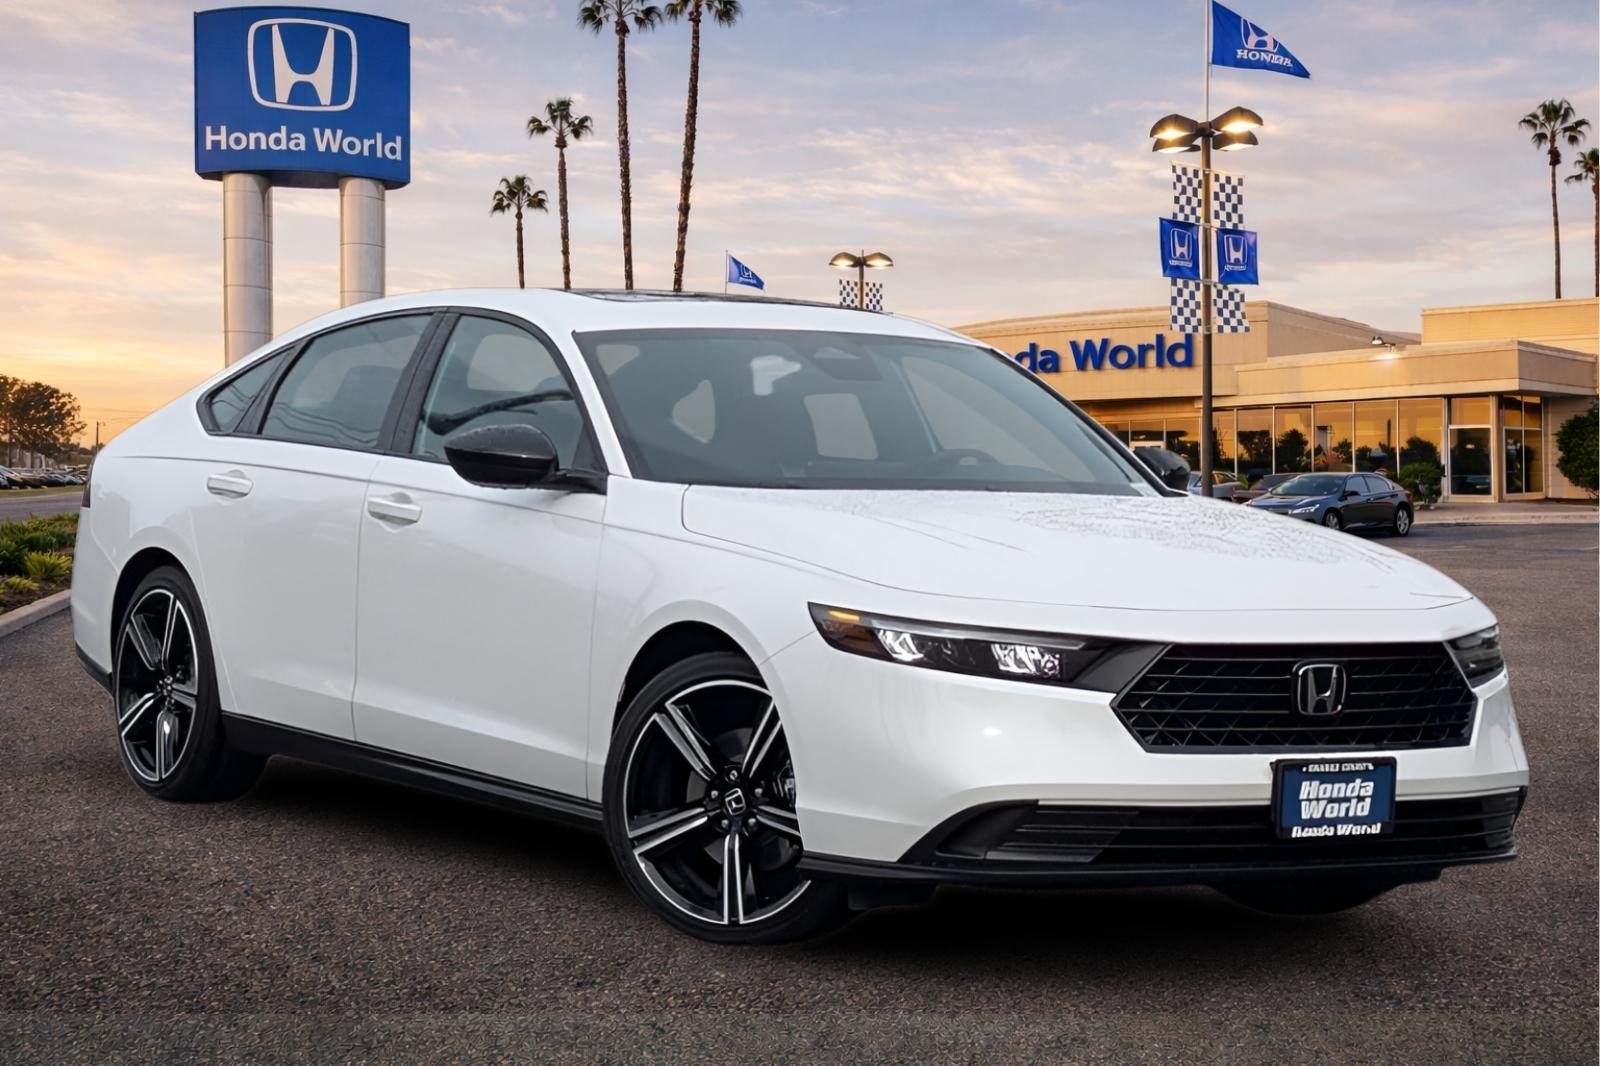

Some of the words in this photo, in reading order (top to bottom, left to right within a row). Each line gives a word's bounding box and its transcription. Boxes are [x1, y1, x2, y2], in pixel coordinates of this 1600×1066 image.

[205, 125, 306, 151] Honda
[313, 127, 402, 161] World
[1069, 333, 1194, 371] World
[1299, 779, 1374, 800] Honda
[1301, 797, 1371, 820] World
